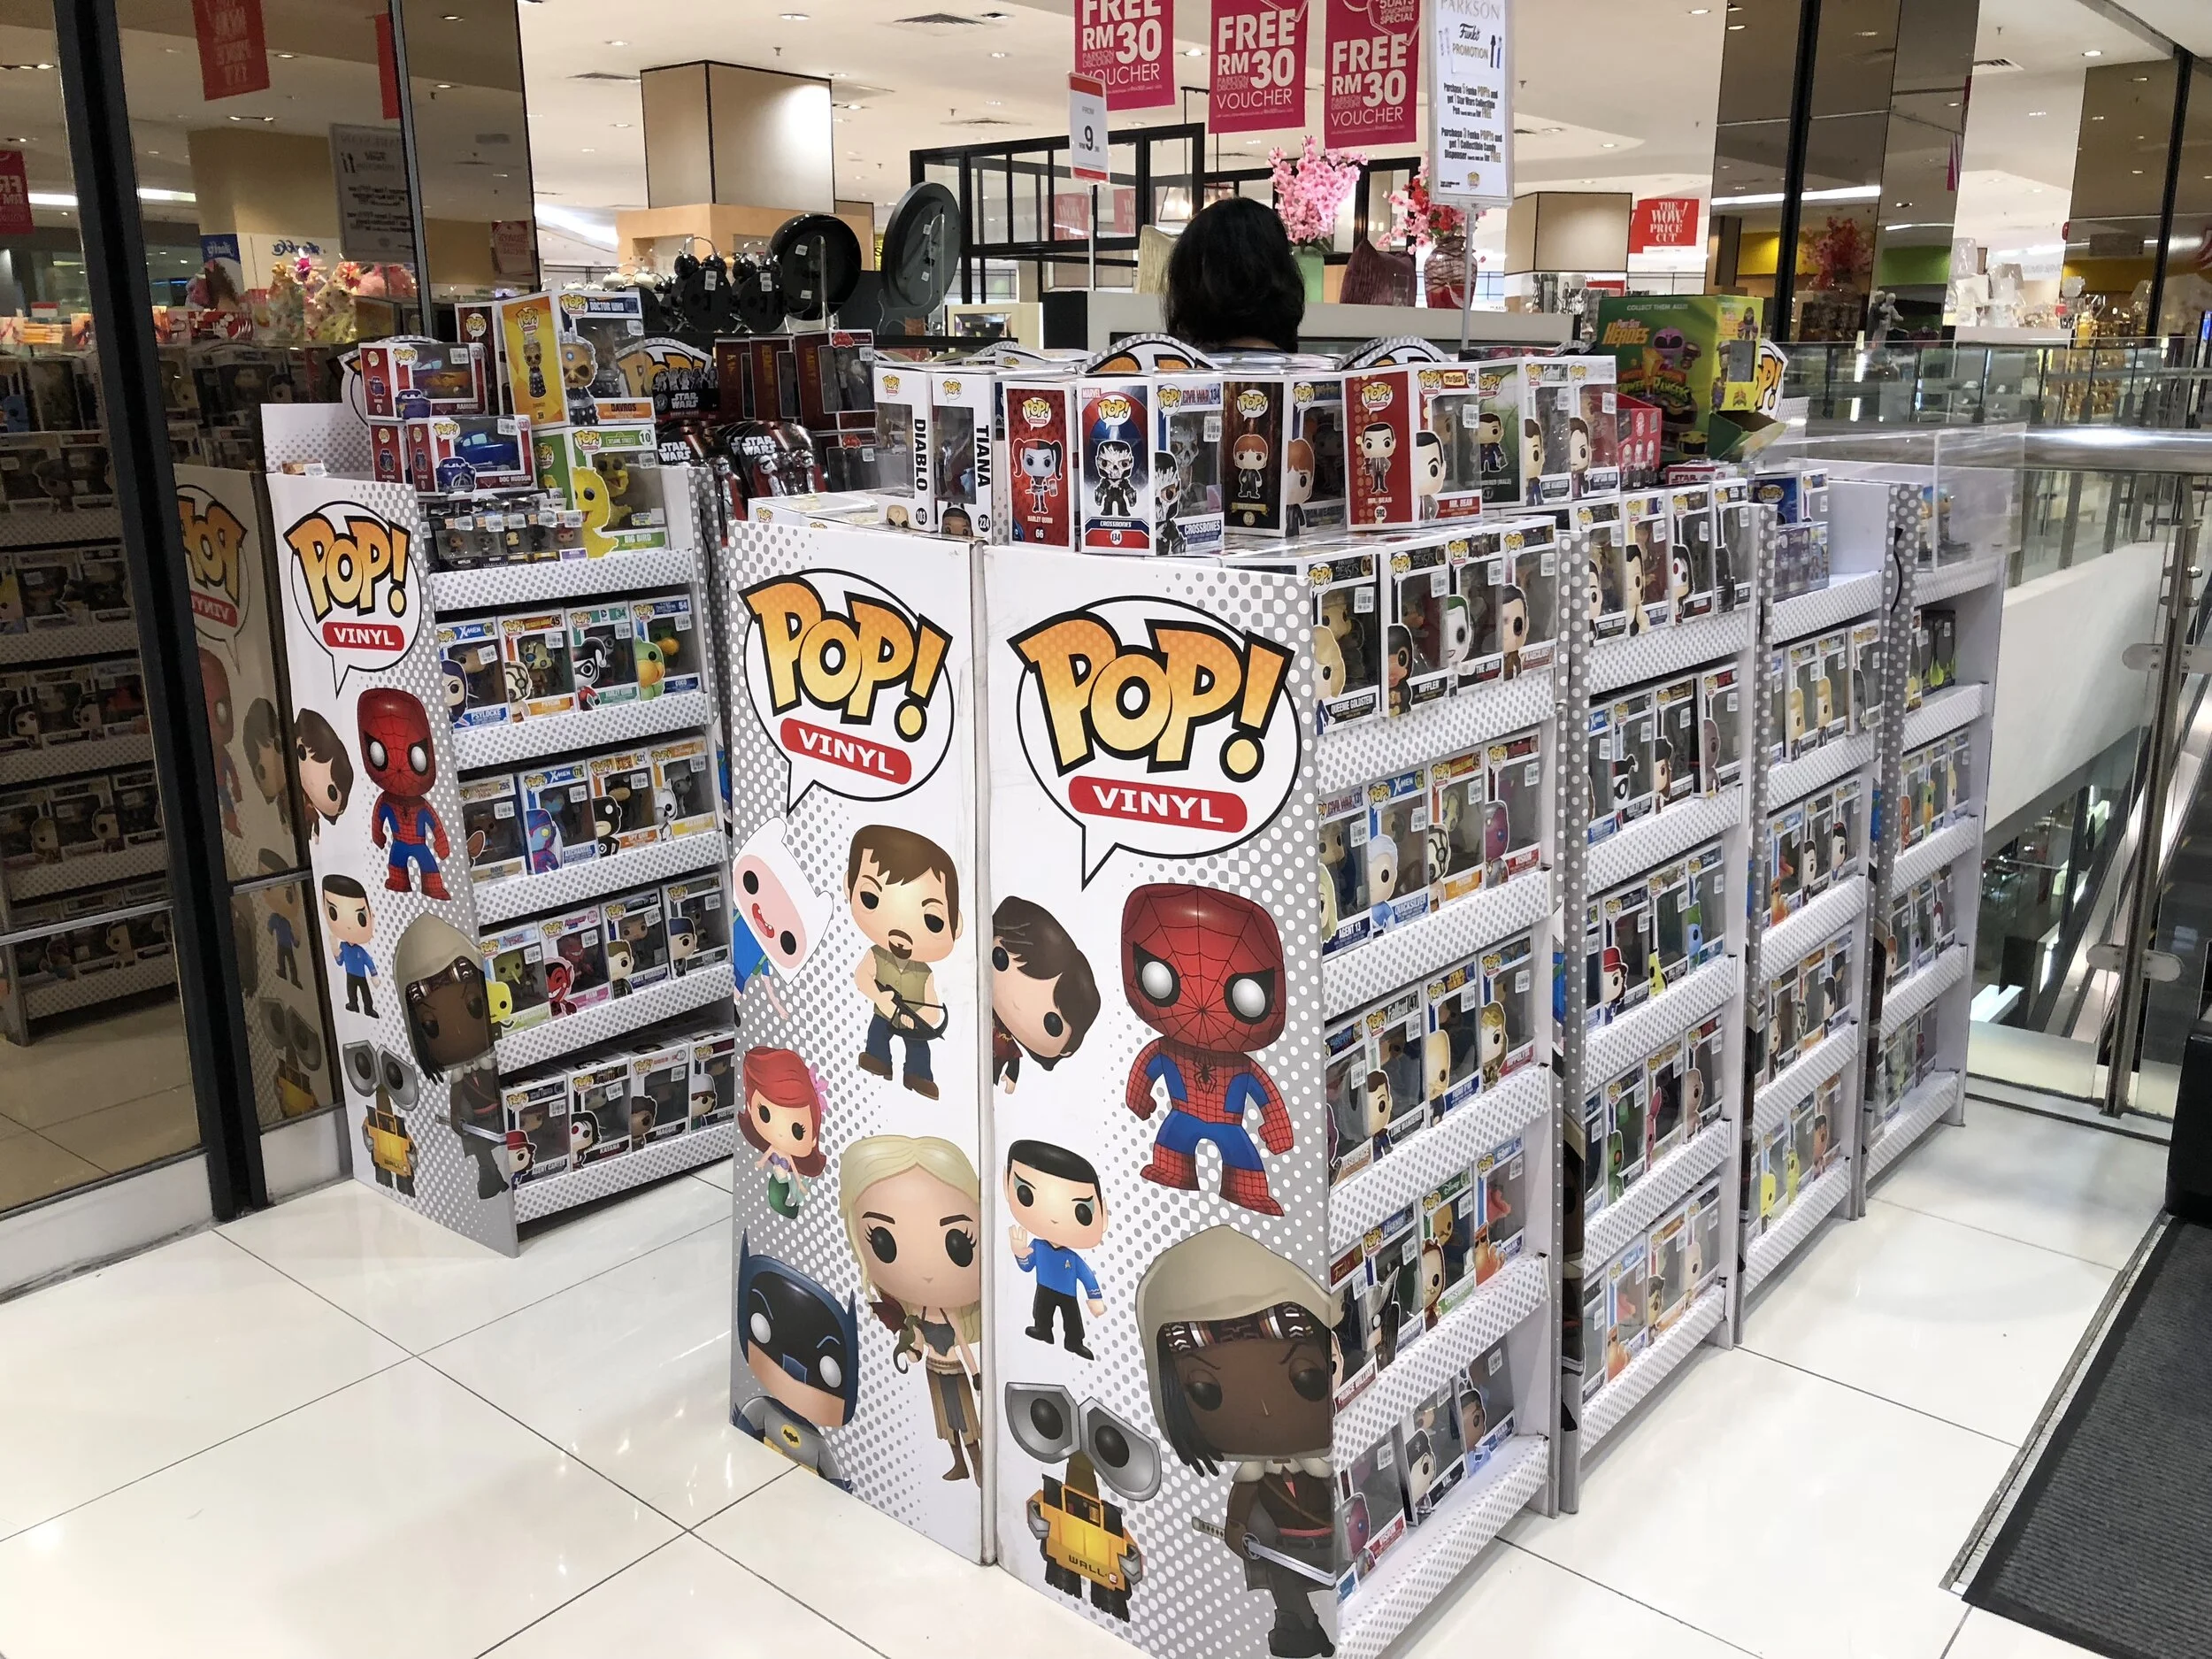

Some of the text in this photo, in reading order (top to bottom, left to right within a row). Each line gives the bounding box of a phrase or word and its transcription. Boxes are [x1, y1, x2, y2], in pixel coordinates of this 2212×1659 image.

[1440, 0, 1501, 19] PARKSON
[1380, 12, 1414, 25] SPECIAL
[1218, 8, 1296, 53] FREE
[1082, 19, 1163, 64] RM 30
[1333, 34, 1407, 74] FREE
[1452, 42, 1488, 59] PROMOTION
[1217, 48, 1295, 88] RM 30
[1332, 69, 1407, 107] RM 30
[1217, 88, 1292, 110] VOUCHER
[1331, 106, 1403, 127] VOUCHER
[1441, 127, 1463, 138] Purchase
[1659, 202, 1678, 211] THE
[1649, 223, 1683, 234] PRICE
[1655, 233, 1678, 242] CUT
[560, 295, 586, 311] POP!
[465, 315, 486, 332] POP!
[1601, 322, 1650, 349] HEROES
[393, 348, 417, 363] POP!
[882, 375, 900, 390] POP!
[942, 379, 963, 396] POP!
[1418, 370, 1440, 388] POP!
[674, 392, 699, 401] STAR
[1082, 388, 1102, 398] MARVEL
[1156, 388, 1181, 408] POP!
[1210, 388, 1220, 400] 134
[1293, 386, 1314, 403] POP!
[1362, 383, 1392, 403] POP!
[611, 403, 636, 412] DAVROS
[671, 398, 699, 409] WARS
[1022, 399, 1050, 420] POP!
[1098, 399, 1129, 419] POP!
[1238, 393, 1267, 412] POP!
[434, 422, 458, 435] POP!
[575, 430, 600, 444] POP!
[640, 433, 651, 443] 10
[741, 435, 777, 447] STAR
[658, 448, 692, 463] WARS
[659, 441, 689, 453] STAR
[741, 443, 777, 456] WARS
[914, 419, 928, 492] DIABLO
[976, 425, 991, 488] TIANA
[916, 511, 927, 523] 103
[978, 518, 990, 530] 224
[1035, 529, 1044, 539] 66
[1184, 520, 1221, 535] CROSSBONES
[1111, 533, 1121, 541] 134
[1504, 533, 1524, 550] POP!
[1448, 541, 1468, 559] POP!
[283, 512, 411, 624] POP!
[1361, 560, 1371, 572] 03
[1390, 556, 1410, 577] POP!
[1308, 566, 1332, 587] POP!
[634, 604, 654, 619] POP!
[678, 601, 687, 610] 54
[502, 619, 524, 636] POP!
[551, 616, 560, 626] 45
[571, 611, 591, 627] POP!
[334, 626, 396, 647] VINYL
[741, 577, 953, 742] POP!
[1476, 660, 1501, 673] THE JOKER
[1419, 680, 1440, 694] NIFFLER
[1007, 612, 1295, 782] POP!
[1331, 695, 1373, 715] QUEENIE GOLDSTEIN
[471, 708, 502, 720] PSYLOCKE
[651, 749, 672, 763] POP!
[797, 727, 895, 776] VINYL
[1488, 745, 1508, 763] POP!
[590, 758, 612, 773] POP!
[1432, 763, 1451, 781] POP!
[525, 775, 545, 789] POP!
[1093, 785, 1224, 825] VINYL
[1370, 786, 1391, 807] POP!
[667, 886, 687, 901] POP!
[605, 904, 626, 920] POP!
[1394, 895, 1427, 915] QUICKSILVER
[542, 921, 565, 937] POP!
[1339, 923, 1354, 939] AGENT
[480, 938, 499, 955] POP!
[1482, 952, 1502, 971] POP!
[1427, 981, 1445, 1000] POP!
[1387, 997, 1408, 1020] Fallout
[1366, 1010, 1386, 1032] POP!
[695, 1046, 714, 1059] POP!
[634, 1059, 654, 1073] POP!
[573, 1075, 594, 1088] POP!
[507, 1093, 528, 1106] POP!
[600, 1143, 619, 1155] KATANA
[1478, 1153, 1494, 1172] POP!
[1443, 1180, 1461, 1195] Disney
[1423, 1192, 1440, 1212] POP!
[1363, 1228, 1383, 1250] POP!
[1338, 1383, 1355, 1405] PRINCE
[1379, 1525, 1396, 1545] VISION
